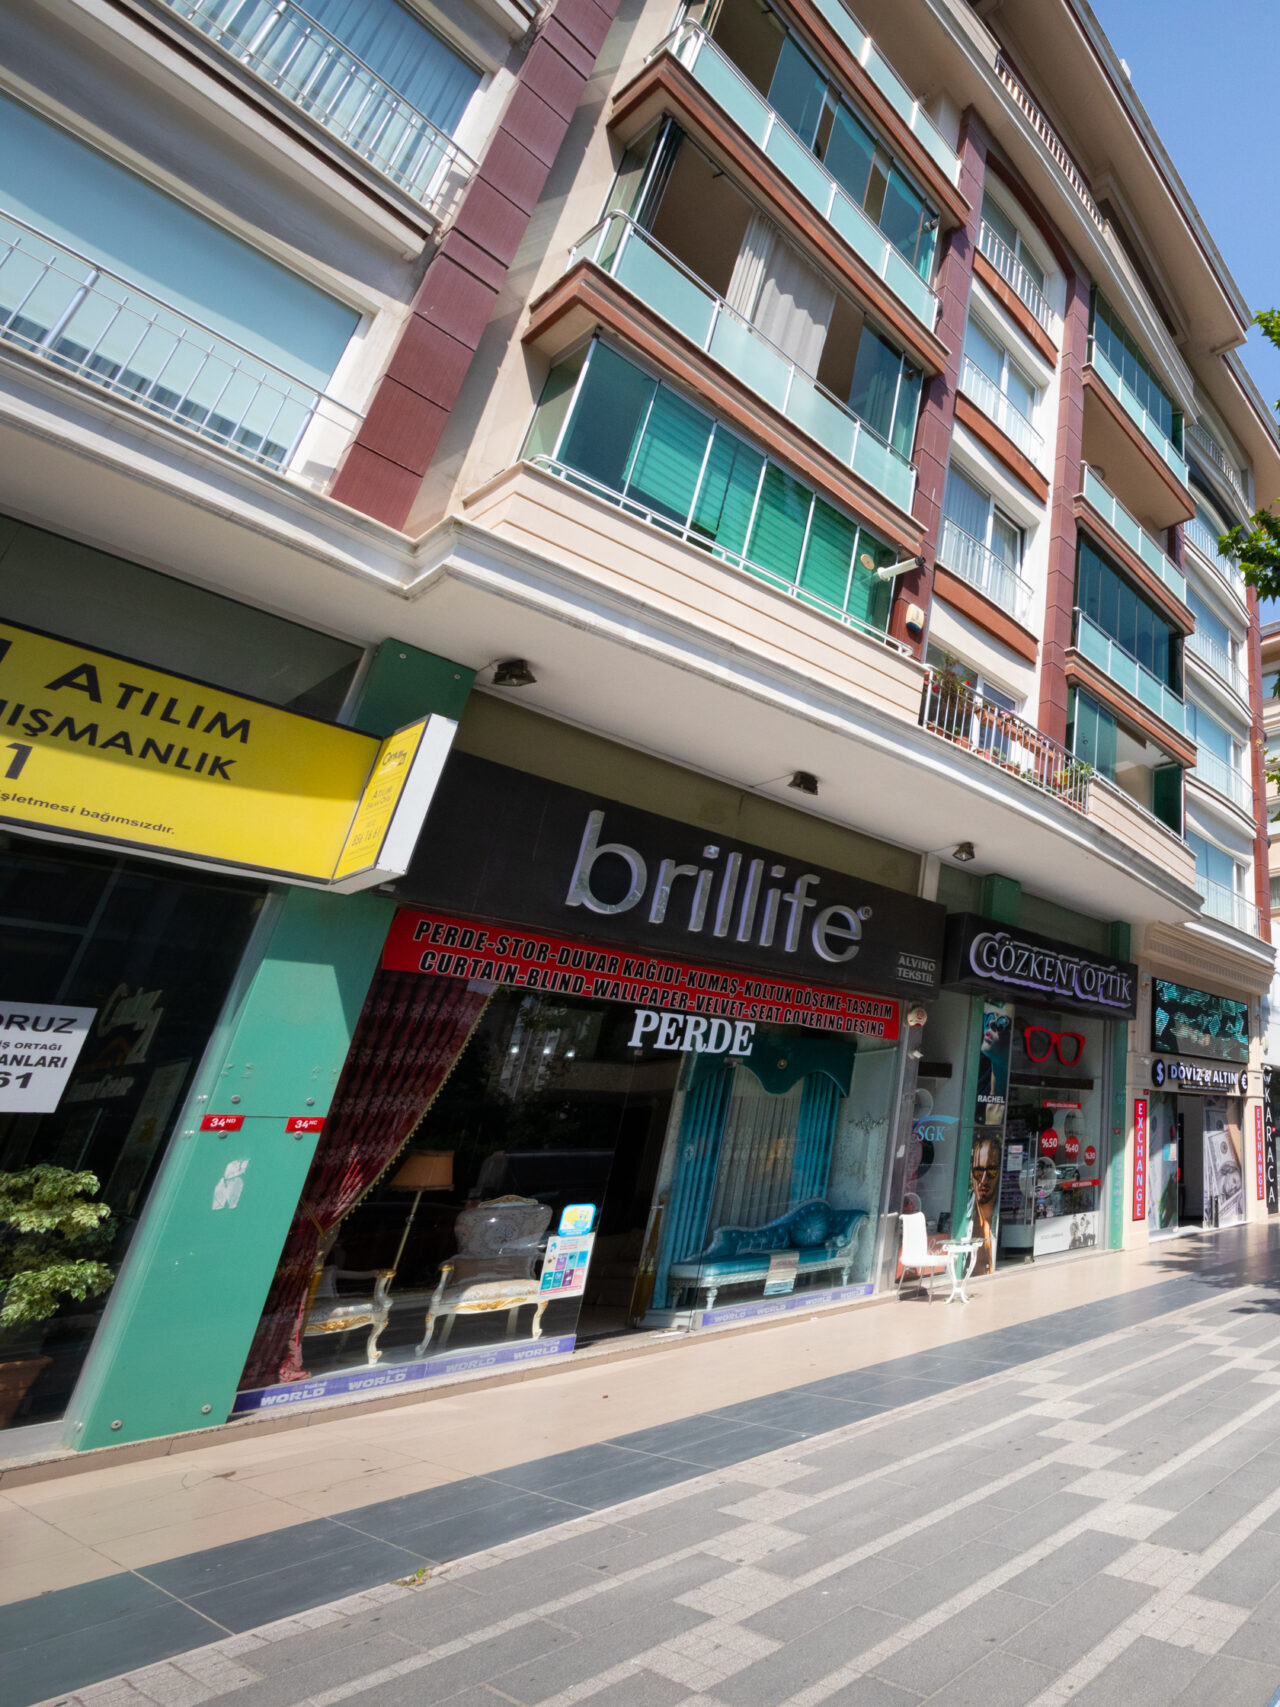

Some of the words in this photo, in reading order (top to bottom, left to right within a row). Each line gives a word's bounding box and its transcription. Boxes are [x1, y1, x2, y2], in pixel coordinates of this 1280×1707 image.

[43, 662, 251, 745] ATILIM
[0, 699, 238, 781] IŞMANLIK
[0, 788, 76, 814] şletmesi
[79, 806, 175, 836] bağımsızdır.
[412, 919, 621, 975] PERDE-STOR-DUVAR
[621, 957, 793, 1004] KAĞIDI-KUMAŞ-KOLTUK
[794, 988, 893, 1020] DÖŞEME-TASARIM
[982, 940, 1079, 990] GÖZKENT
[1082, 966, 1133, 1000] OPTİK
[418, 950, 782, 1023] CURTAIN-BLIND-WALLPAPER-VELVET-SEAT
[783, 1008, 844, 1032] COVERING
[844, 1016, 885, 1037] DESING
[0, 1013, 78, 1034] RUZ
[626, 1008, 756, 1057] PERDE
[14, 1042, 63, 1051] ORTAĞI
[1170, 1062, 1202, 1082] DÖVİZ
[1213, 1070, 1239, 1086] ALTIN
[977, 1095, 1005, 1104] RACHEL
[916, 1125, 946, 1142] SGK
[1041, 1137, 1058, 1149] %50
[1264, 1087, 1276, 1203] KARACA
[1065, 1143, 1079, 1153] %40
[1135, 1103, 1144, 1217] EXCHANGE
[1256, 1108, 1264, 1198] EXCHANGE
[445, 1356, 497, 1373] WORLD
[513, 1345, 559, 1361] WORLD
[348, 1373, 407, 1391] WORLD
[260, 1387, 326, 1407] WORLD
